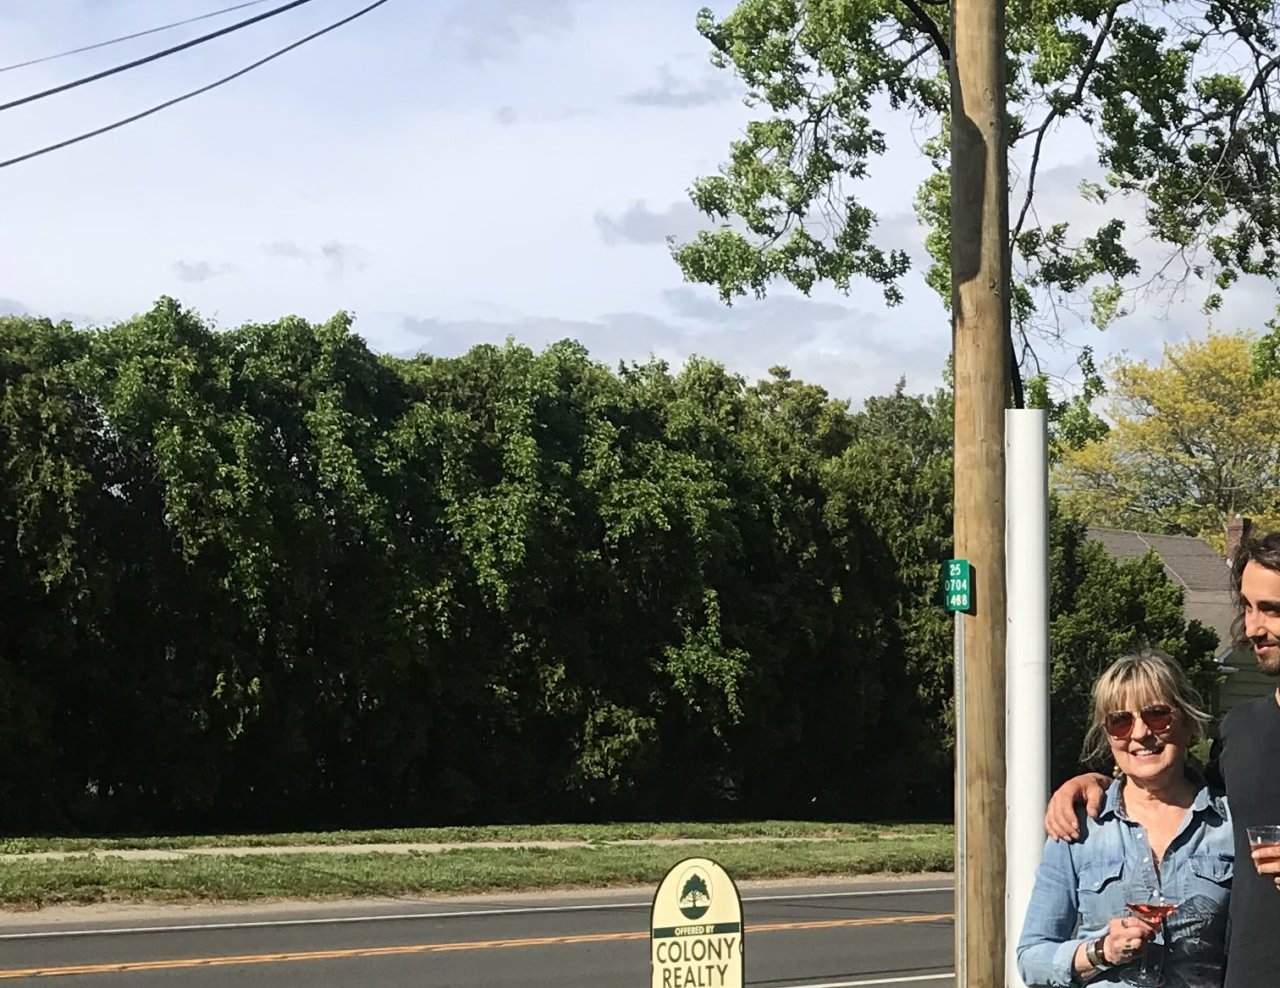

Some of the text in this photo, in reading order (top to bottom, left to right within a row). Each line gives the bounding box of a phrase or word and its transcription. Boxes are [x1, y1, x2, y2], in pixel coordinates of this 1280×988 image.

[949, 564, 961, 576] 25
[944, 579, 967, 591] 0704
[674, 924, 715, 936] OFFERED BY
[656, 937, 736, 964] COLONY
